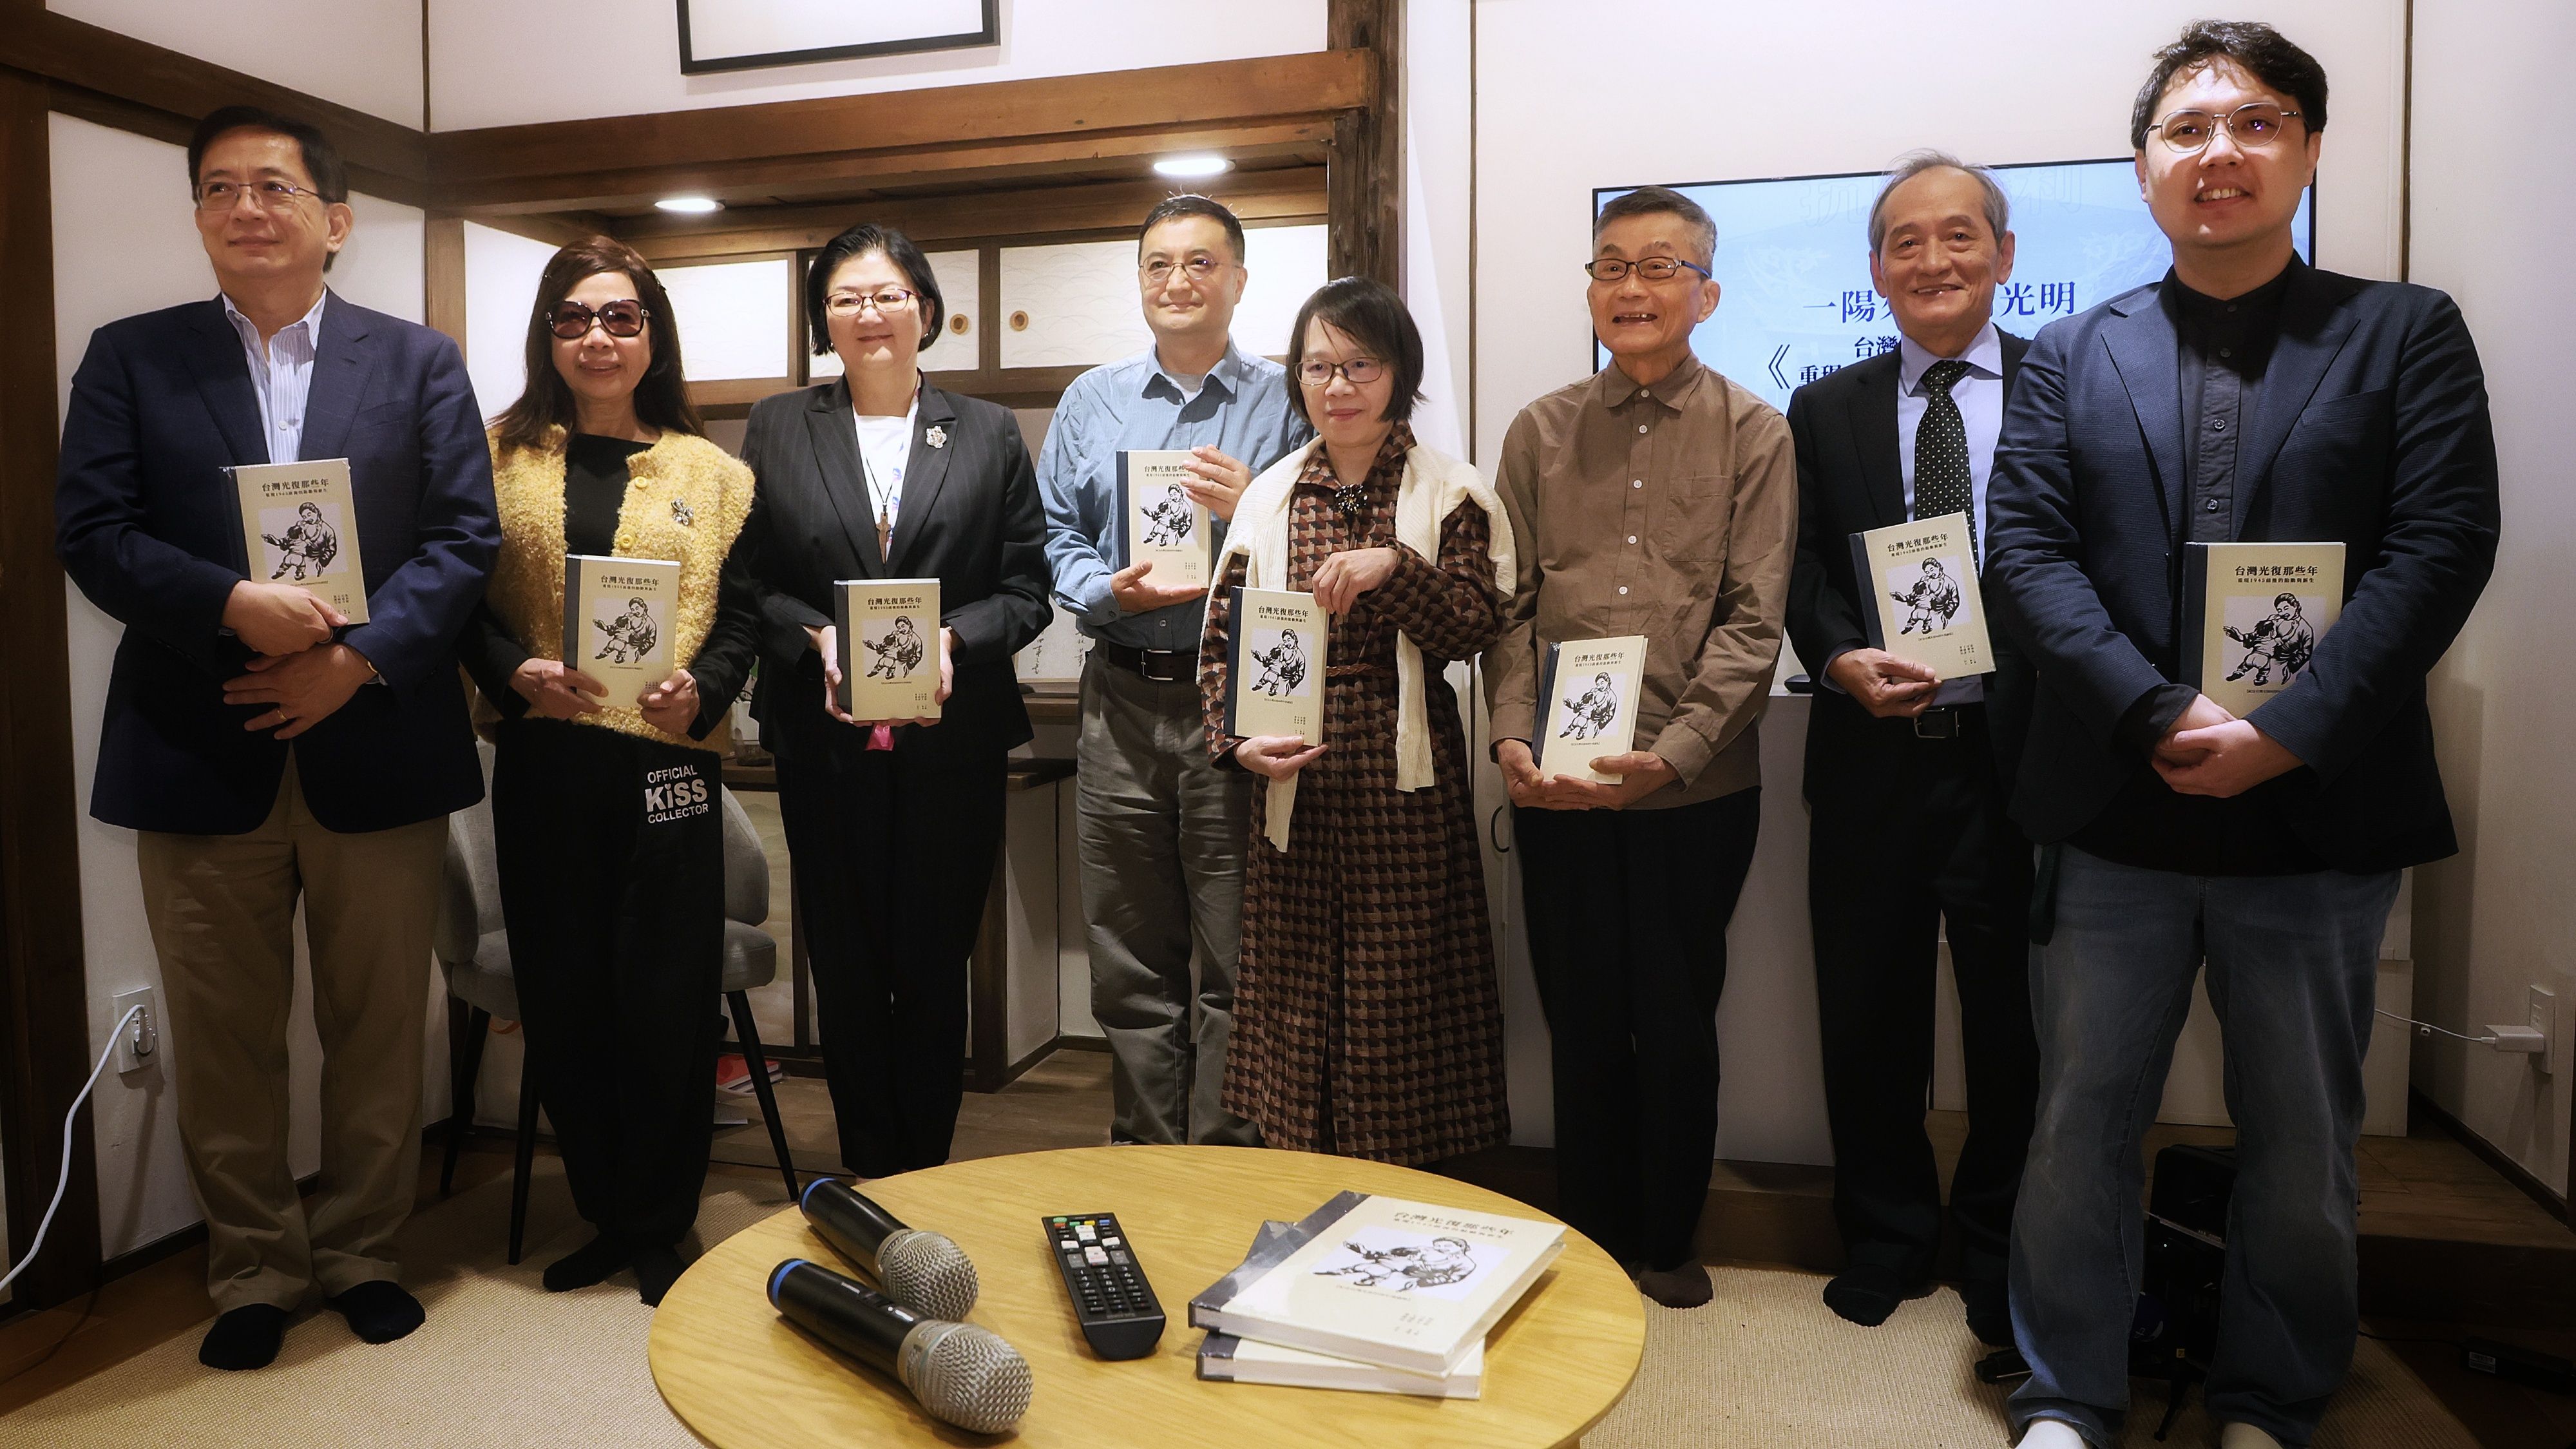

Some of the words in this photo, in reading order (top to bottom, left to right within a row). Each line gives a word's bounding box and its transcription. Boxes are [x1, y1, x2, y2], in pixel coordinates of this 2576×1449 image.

[262, 478, 329, 492] 台灣光復那些年
[1887, 533, 1949, 552] 台灣光復那些年
[2235, 566, 2318, 576] 台灣光復那些年
[600, 575, 660, 586] 台灣光復那些年
[867, 597, 922, 606] 台灣光復那些年
[1258, 606, 1309, 618] 台灣光復那些年
[1574, 651, 1625, 662] 台灣光復那些年
[647, 765, 698, 783] OFFICIAL
[647, 803, 709, 823] COLLECTOR
